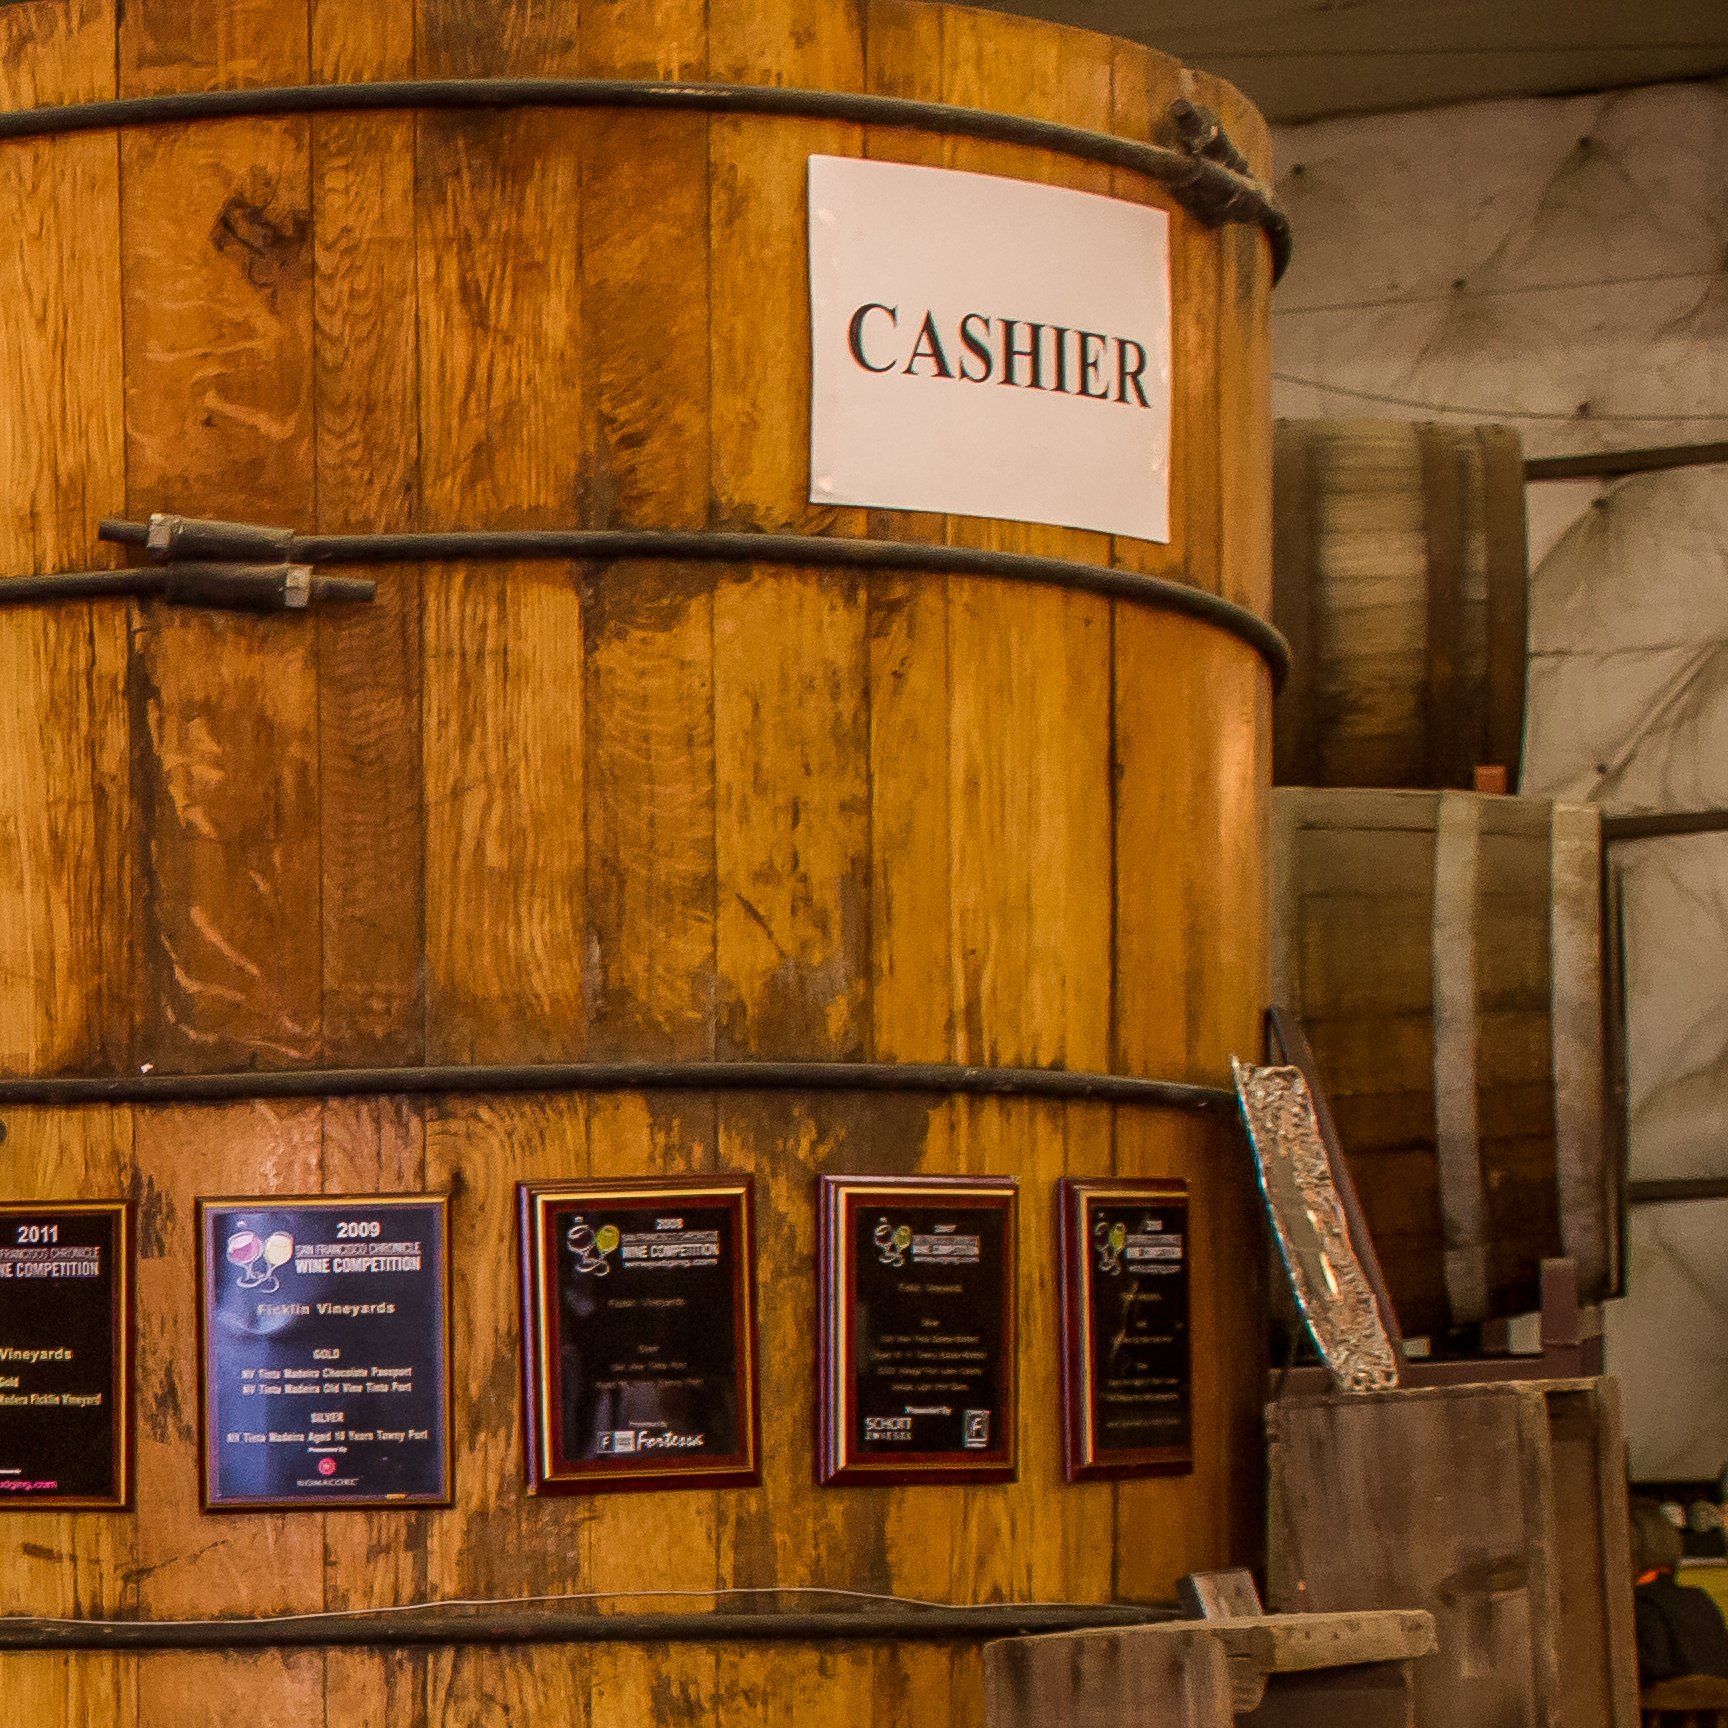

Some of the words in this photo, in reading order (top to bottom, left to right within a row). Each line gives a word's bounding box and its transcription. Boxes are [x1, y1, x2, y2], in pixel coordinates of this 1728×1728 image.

[847, 303, 1151, 409] CASHIER
[17, 1225, 59, 1243] 2011
[337, 1221, 382, 1238] 2009
[16, 1261, 99, 1278] COMPETITION
[296, 1258, 330, 1274] WINE
[333, 1256, 422, 1273] COMPETITION
[317, 1302, 396, 1317] Vineyards
